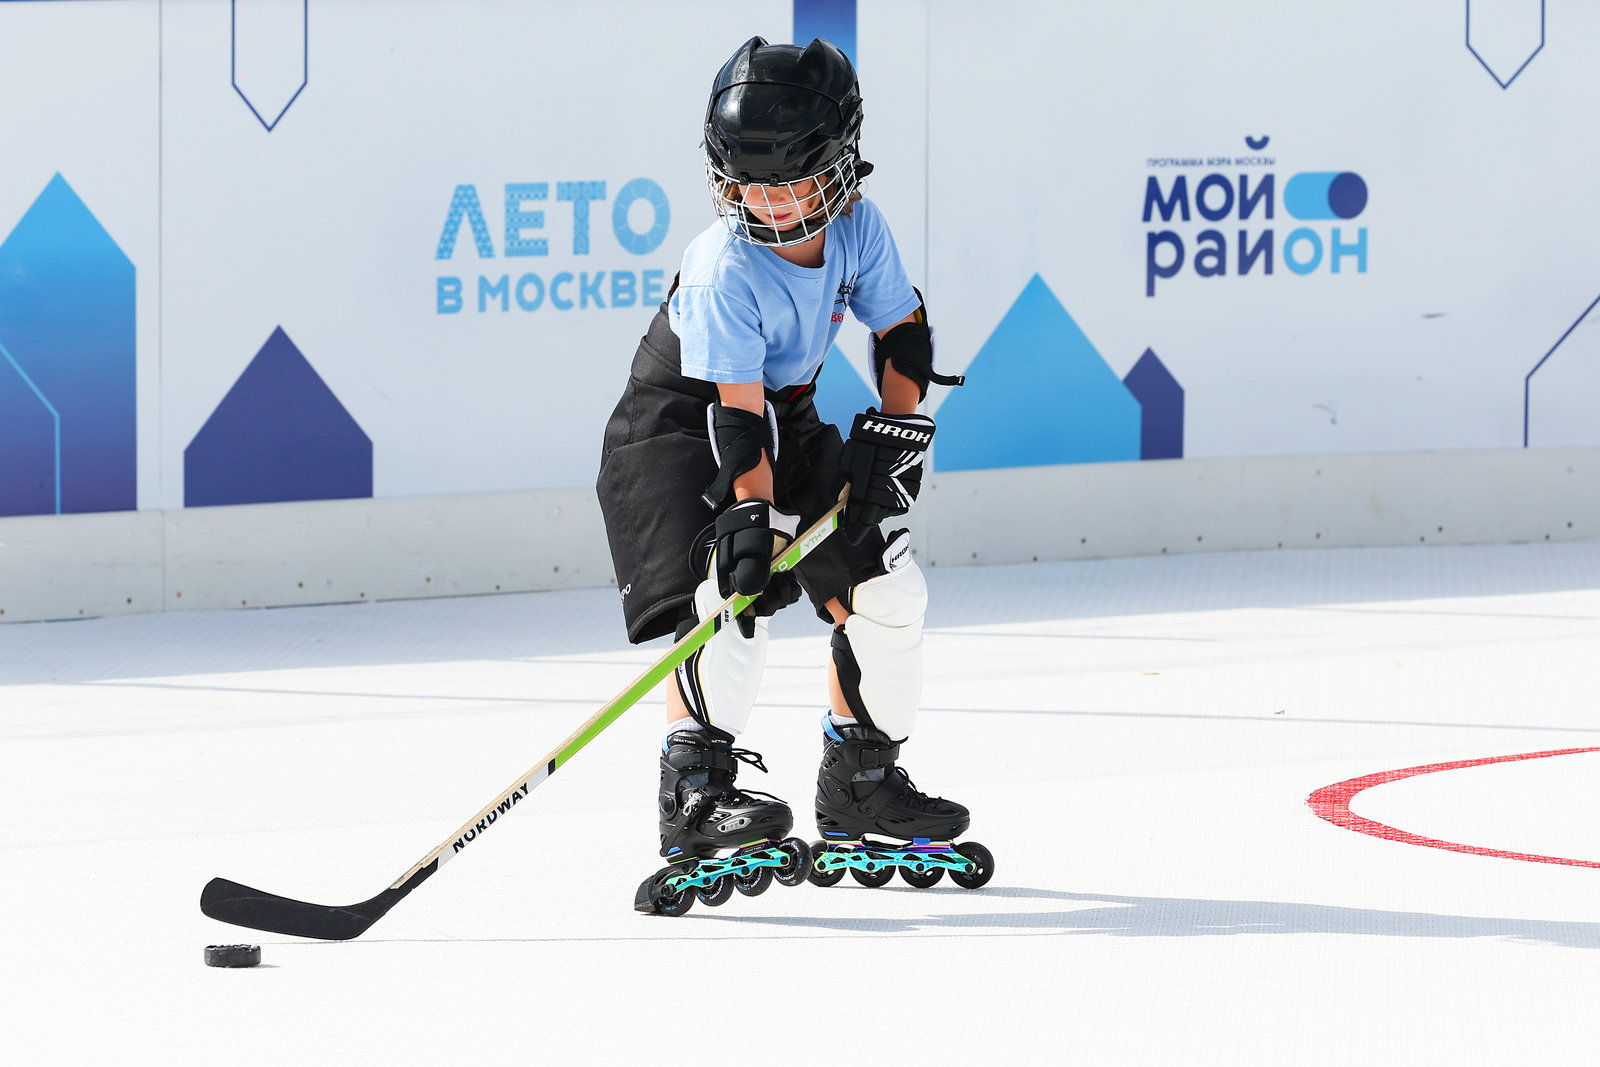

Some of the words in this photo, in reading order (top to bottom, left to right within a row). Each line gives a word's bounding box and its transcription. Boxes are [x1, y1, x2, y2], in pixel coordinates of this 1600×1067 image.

[1146, 157, 1204, 168] ПРОГРАММА
[1207, 157, 1232, 167] МЭРА
[1235, 156, 1276, 166] МОСКВЫ
[434, 177, 671, 260] ЛЕТО
[436, 276, 463, 315] В
[478, 269, 665, 313] МОСКВЕ
[862, 419, 932, 444] KROK
[452, 782, 529, 853] NORDWAY
